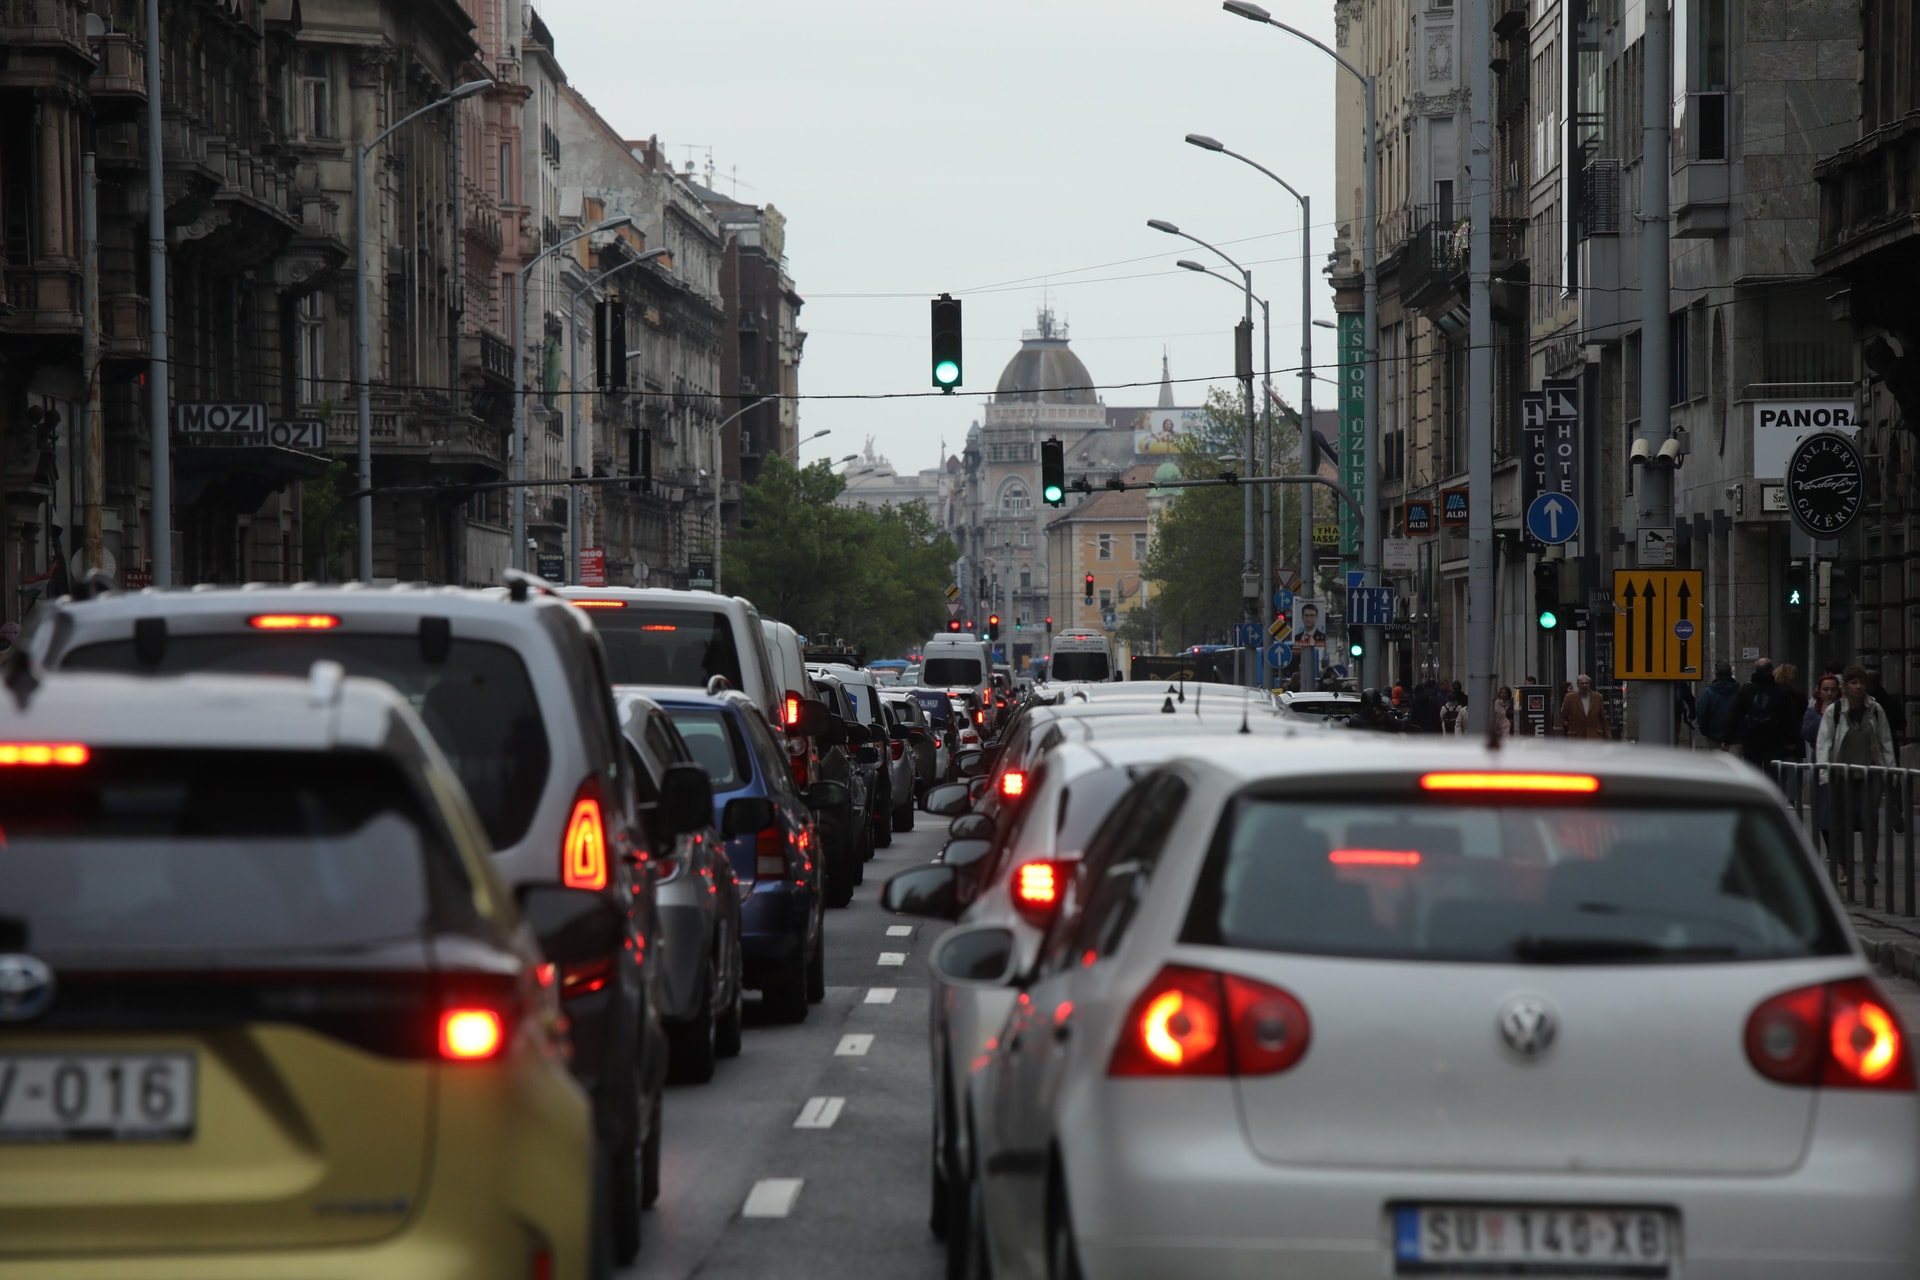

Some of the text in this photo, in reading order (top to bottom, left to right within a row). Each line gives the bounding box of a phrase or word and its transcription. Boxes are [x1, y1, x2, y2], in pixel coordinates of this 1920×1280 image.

[1350, 317, 1364, 399] ASTOR
[183, 405, 258, 431] MOZI
[1797, 441, 1856, 473] GALLERY
[1409, 521, 1428, 529] ALDI
[1798, 496, 1857, 527] GALÉRIA
[1384, 623, 1411, 631] LIVING
[1427, 1212, 1479, 1253] SU
